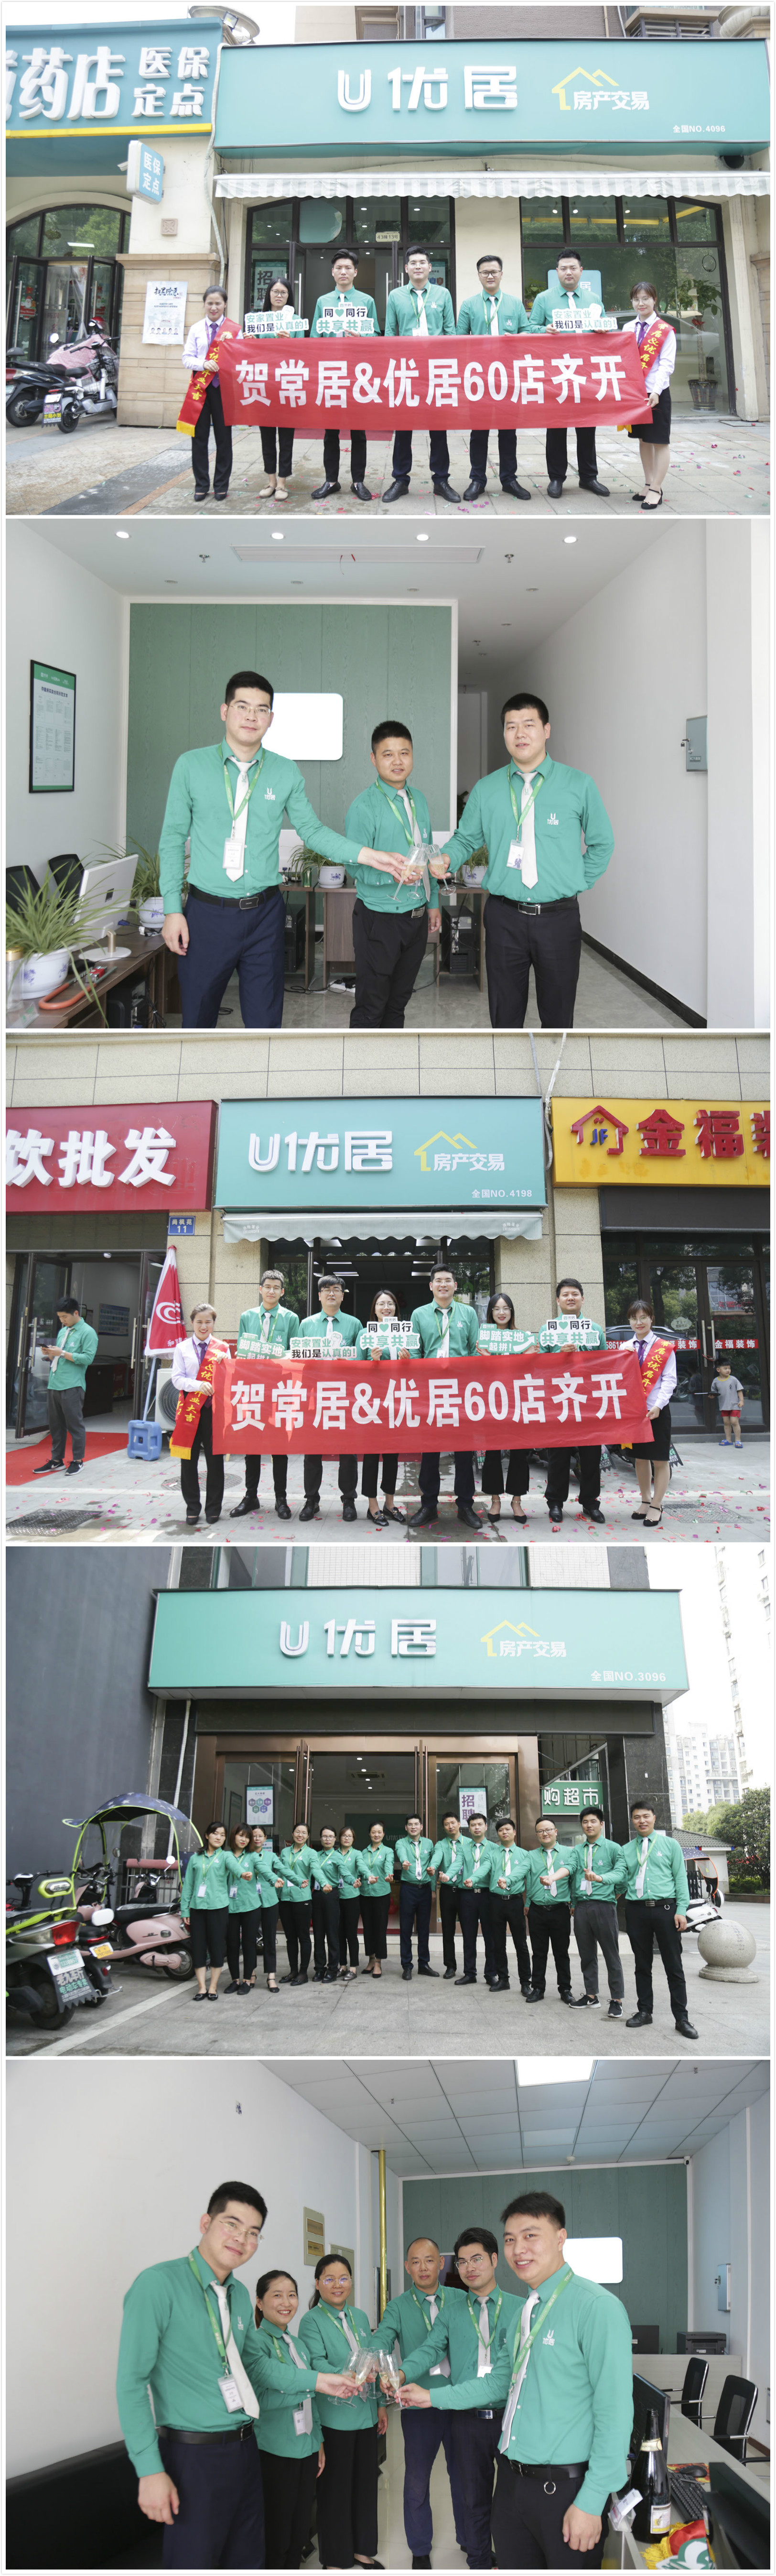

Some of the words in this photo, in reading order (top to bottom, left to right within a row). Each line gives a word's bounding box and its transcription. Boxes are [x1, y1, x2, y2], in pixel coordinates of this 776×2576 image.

[139, 47, 211, 80] 医保
[131, 84, 205, 118] 定点
[573, 91, 649, 111] 房产交易
[672, 125, 726, 134] 全国NO.4096
[143, 152, 162, 176] 医保
[142, 172, 161, 196] 定点
[247, 313, 283, 324] 安家置业
[324, 309, 334, 317] 同
[346, 308, 366, 317] 同行
[247, 320, 307, 334] 我们是认真的!
[318, 320, 373, 332] 共享共赢
[555, 320, 616, 329] 我们是认真的!
[236, 354, 626, 409] 贺常居&优居60店齐开
[6, 1127, 176, 1188] 饮批发
[434, 1153, 505, 1172] 房产交易
[471, 1189, 532, 1198] 全国NO.4198
[368, 1323, 377, 1333] 同
[391, 1323, 411, 1333] 同行
[548, 1321, 557, 1330] 同
[570, 1320, 591, 1330] 同行
[362, 1335, 419, 1348] 共享共赢
[479, 1330, 524, 1342] 脚踏实地
[541, 1332, 598, 1345] 共享共赢
[238, 1339, 283, 1357] 脚踏实地
[291, 1338, 332, 1348] 安家置业
[479, 1342, 512, 1352] 一起拼!
[606, 1341, 626, 1349] 5861
[715, 1339, 755, 1349] 金福装饰
[291, 1348, 356, 1359] 我们是认真的!
[642, 1340, 671, 1394] 常居&优居开
[231, 1372, 627, 1431] 贺常居&优居60店齐开
[499, 1641, 567, 1658] 房产交易
[591, 1670, 666, 1682] 全国NO.3096
[544, 1787, 599, 1806] 购超市
[56, 1967, 85, 1986] 老九车行
[59, 1978, 88, 1994] 电动车专卖
